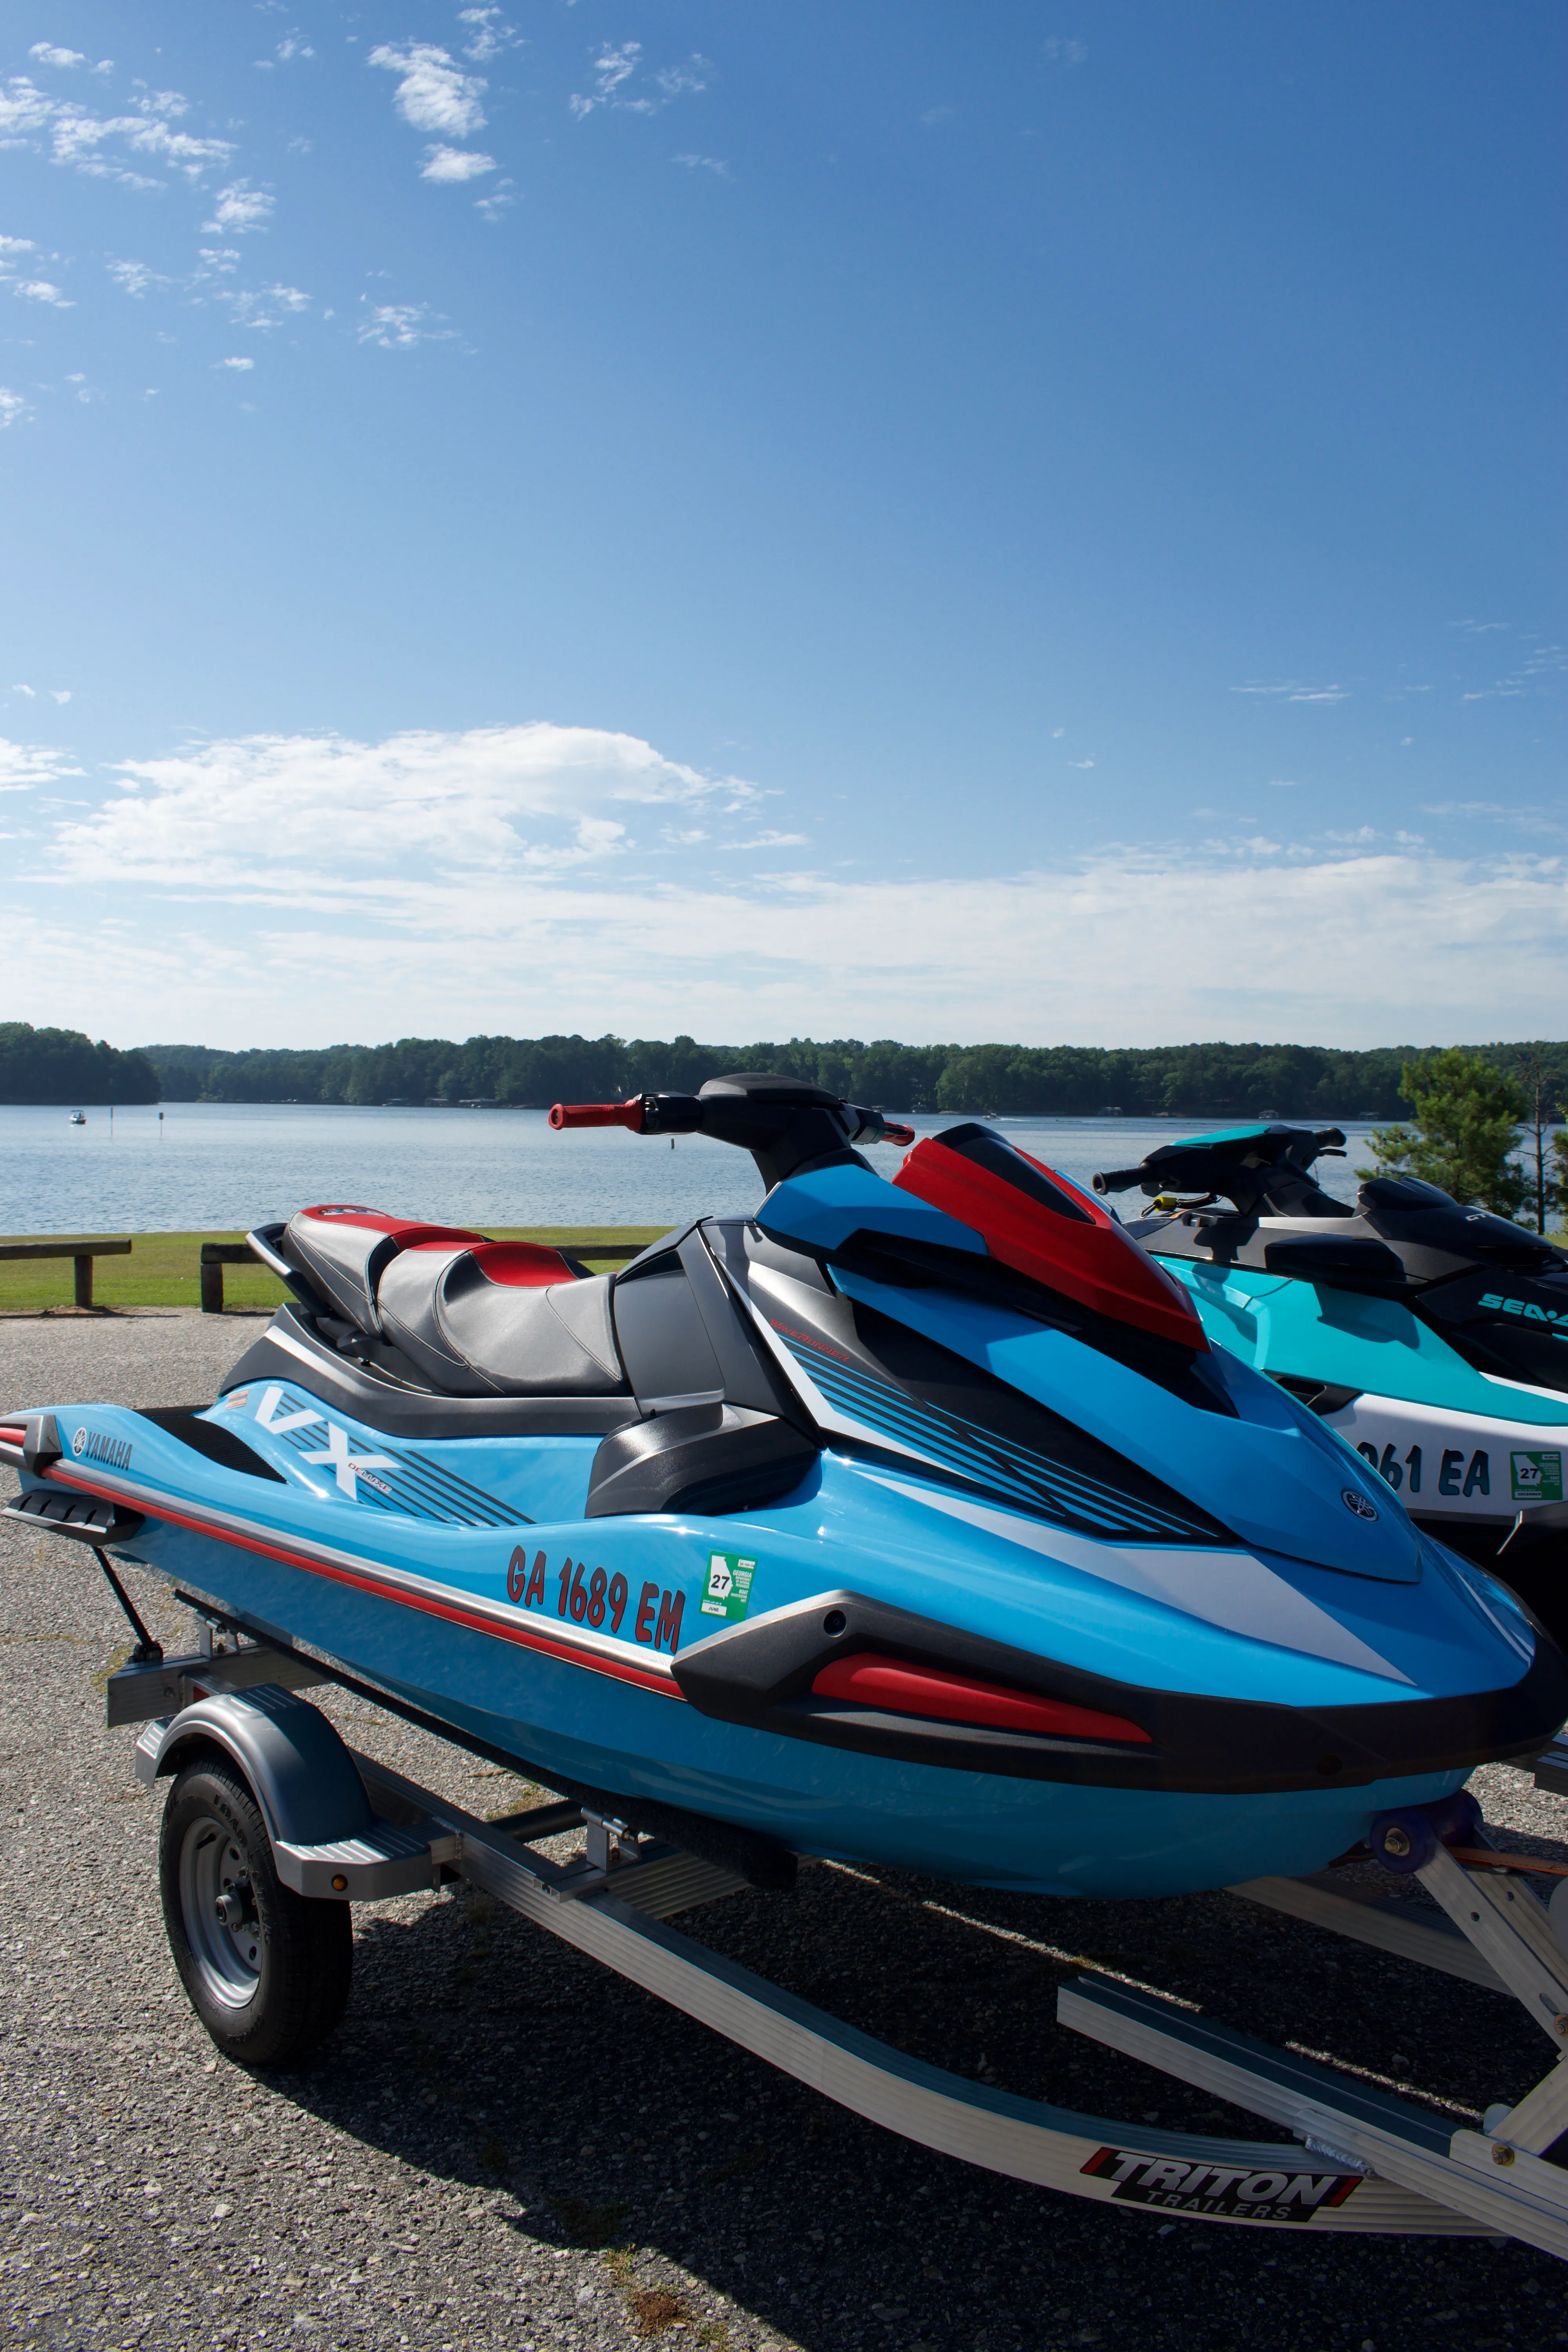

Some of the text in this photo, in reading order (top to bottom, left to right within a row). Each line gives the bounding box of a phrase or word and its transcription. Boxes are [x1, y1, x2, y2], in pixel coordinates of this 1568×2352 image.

[86, 1431, 133, 1471] YAMAHA
[254, 1386, 403, 1501] VX
[348, 1462, 392, 1493] DELUXE
[1438, 1448, 1490, 1497] EA
[1520, 1468, 1538, 1479] 27
[711, 1574, 730, 1590] 27
[733, 1569, 752, 1578] GEORGIA
[507, 1544, 686, 1654] GA 1689 EM
[214, 1793, 247, 1846] LOAD
[1110, 2152, 1338, 2205] TRITON
[1145, 2190, 1292, 2220] TRAILERS
